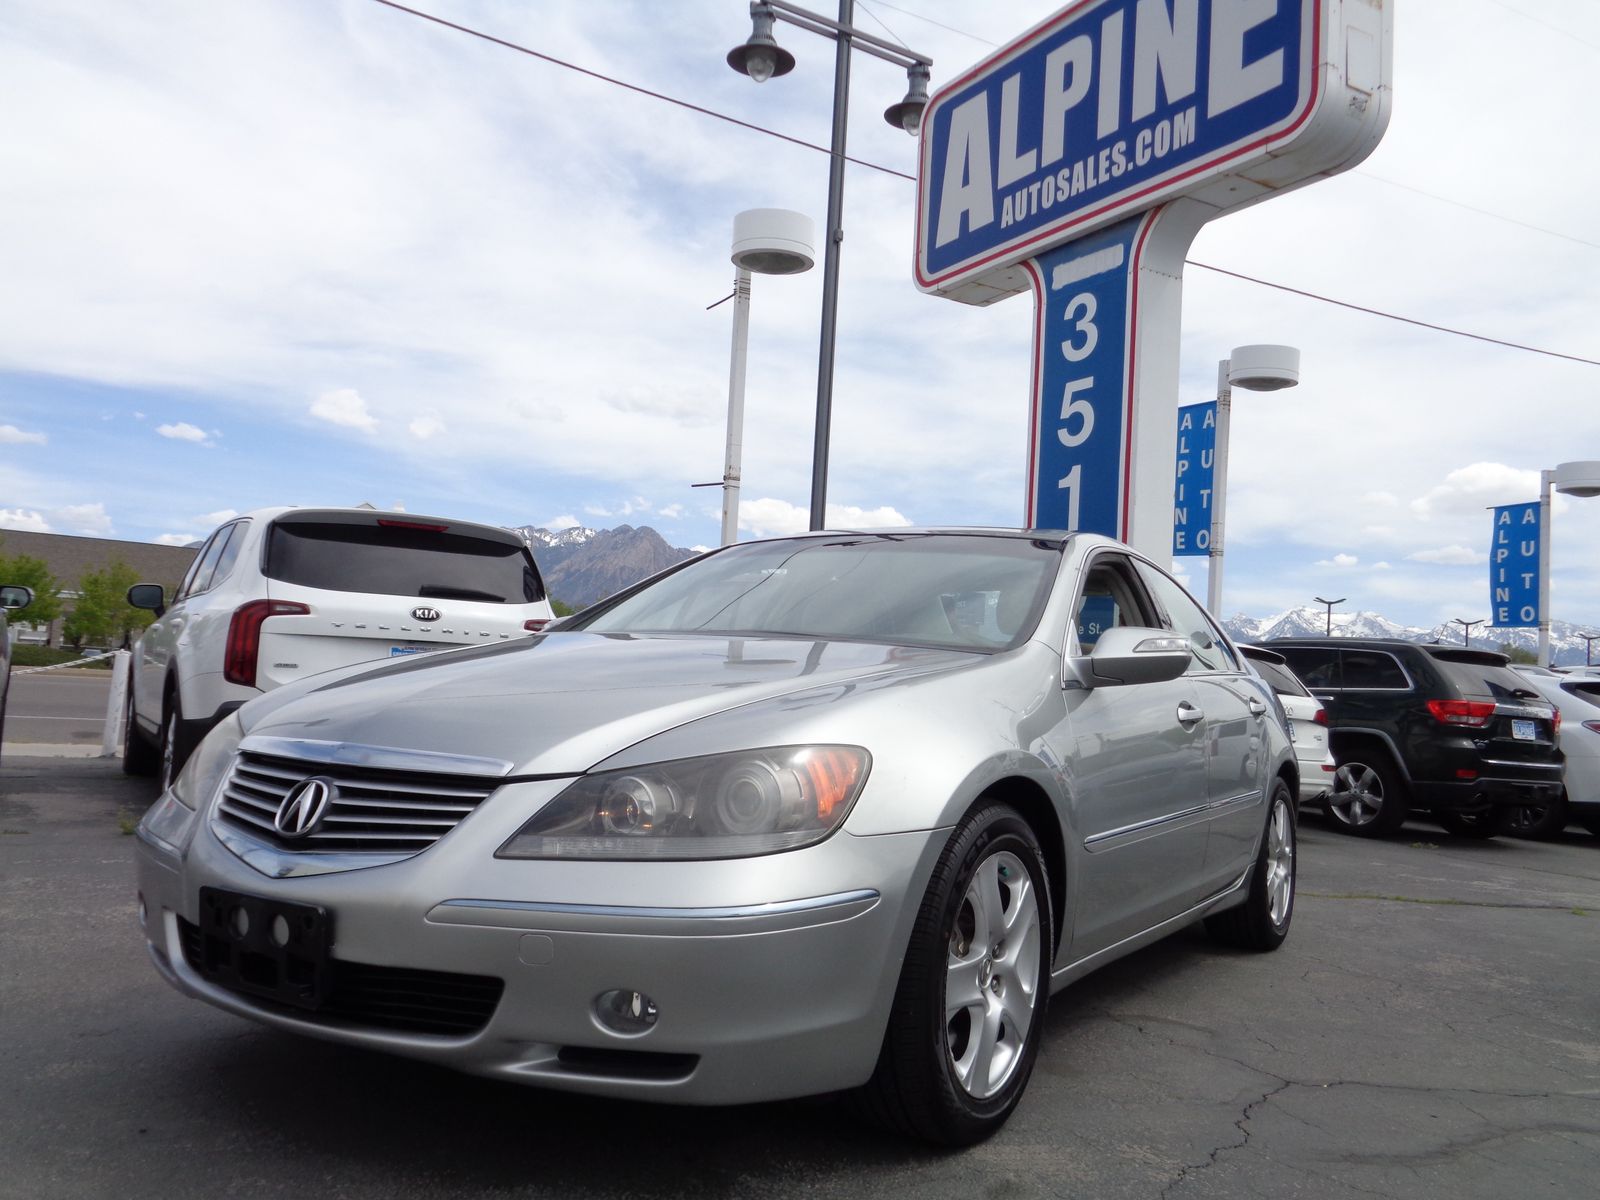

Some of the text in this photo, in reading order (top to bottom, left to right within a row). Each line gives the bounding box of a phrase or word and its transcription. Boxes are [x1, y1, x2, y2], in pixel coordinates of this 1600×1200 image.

[936, 0, 1285, 249] ALPINE
[1000, 106, 1196, 229] AUTOSALES.COM
[1057, 292, 1099, 532] 351
[1174, 412, 1193, 550] ALPINE
[1196, 409, 1215, 550] AUTO
[415, 608, 438, 619] KIA
[1496, 510, 1511, 622] ALPINE
[1520, 508, 1535, 622] AUTO
